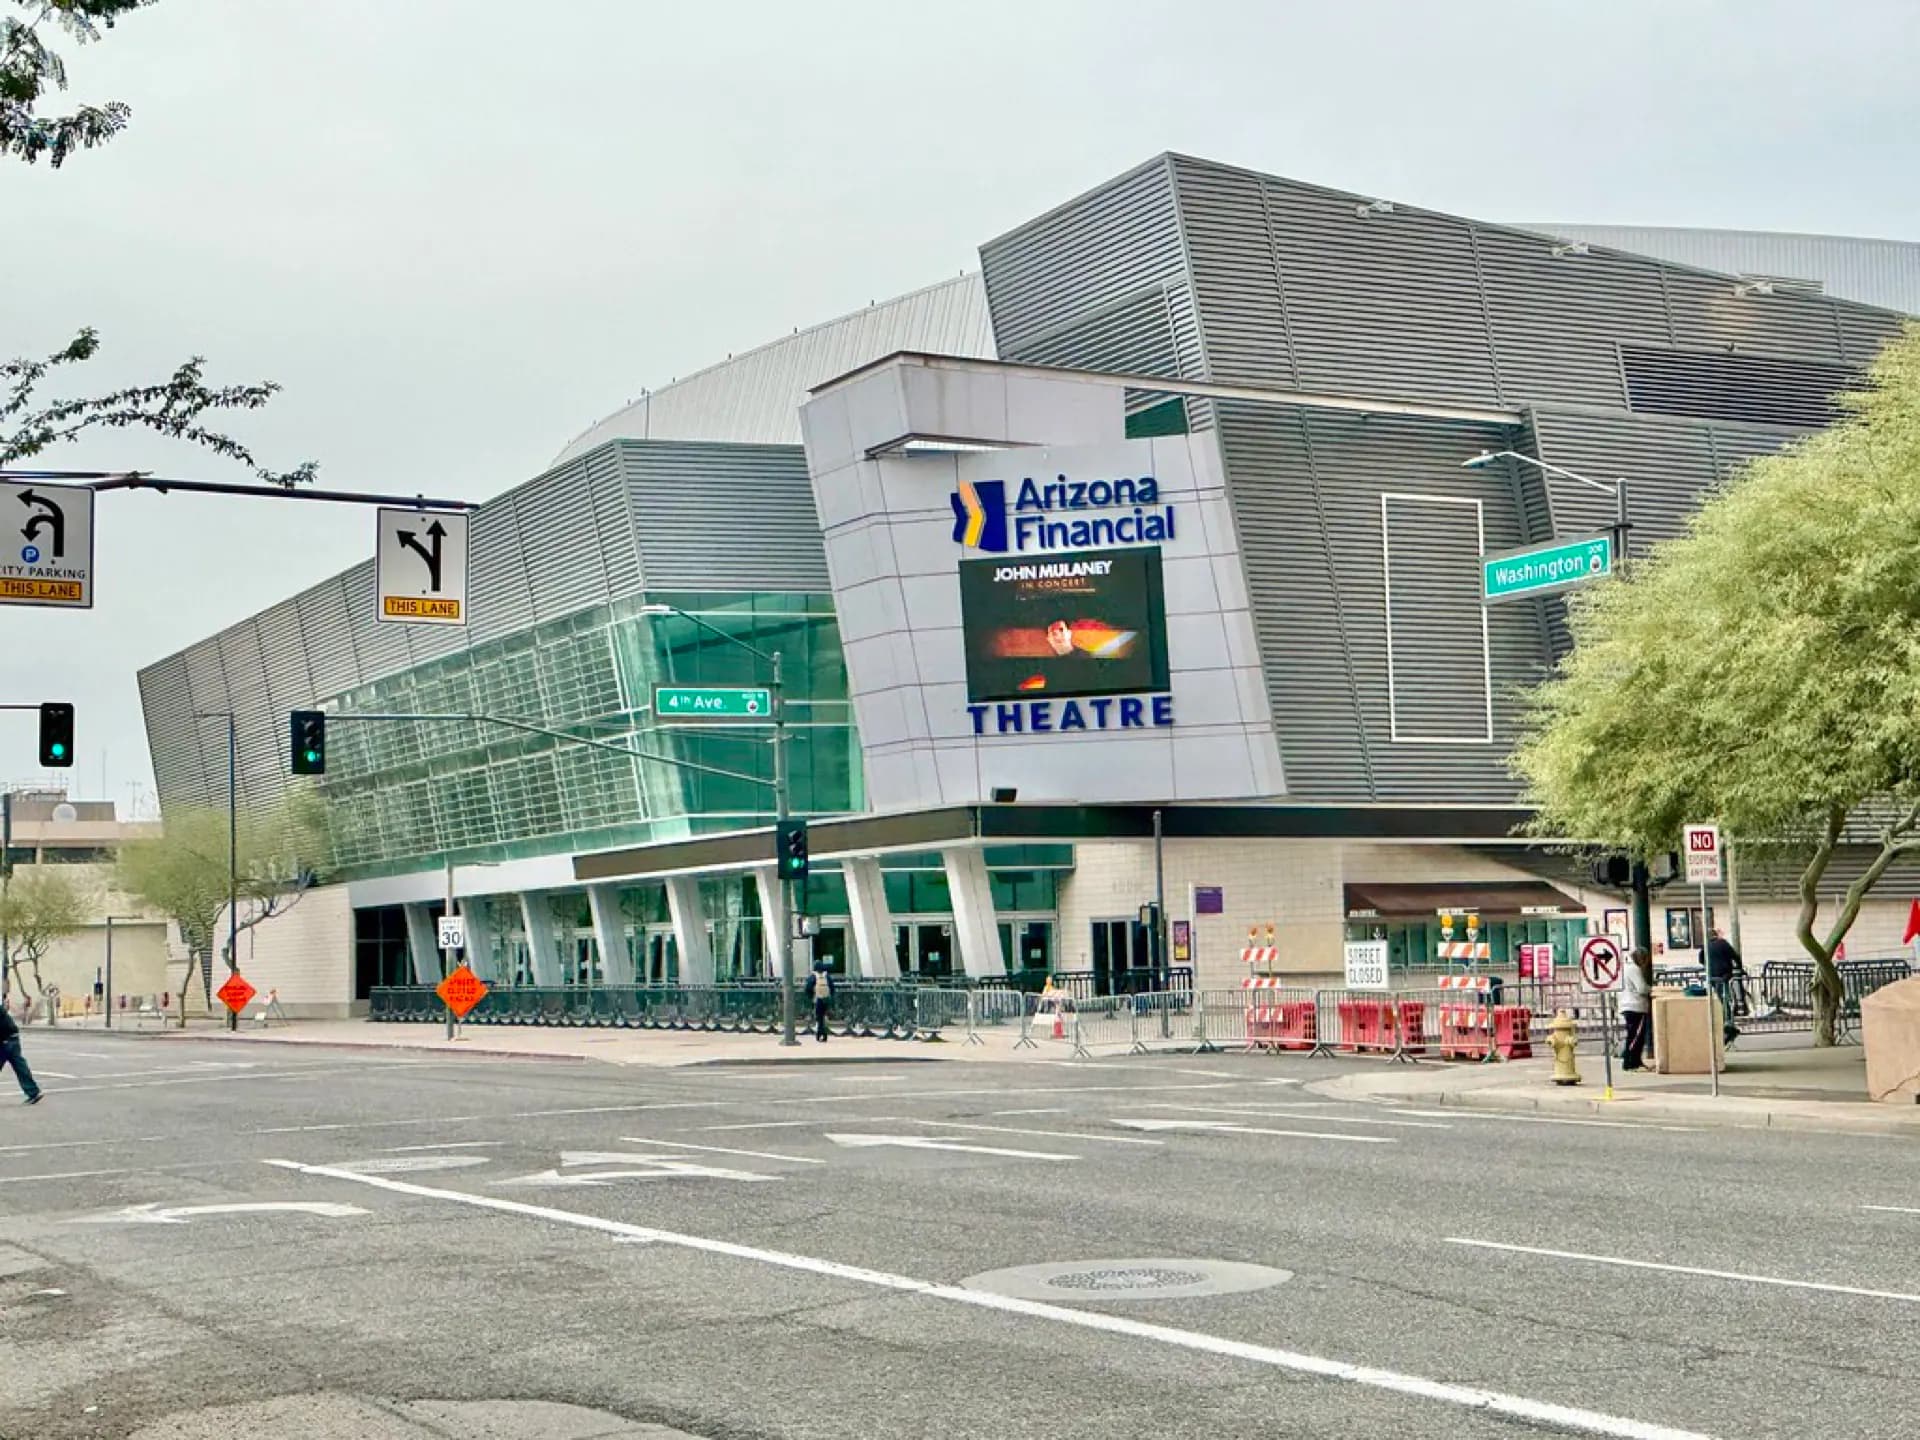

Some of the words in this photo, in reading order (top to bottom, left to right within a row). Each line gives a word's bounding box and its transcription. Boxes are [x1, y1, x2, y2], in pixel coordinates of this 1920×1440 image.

[1015, 474, 1157, 510] Arizona
[1015, 505, 1175, 550] Financial
[0, 565, 24, 576] ITY
[29, 566, 86, 579] PARKING
[993, 564, 1037, 582] JOHN
[1038, 560, 1112, 578] MULANEY
[1495, 556, 1584, 586] Washington
[4, 581, 34, 594] THIS
[38, 583, 77, 597] LANE
[389, 600, 417, 612] THIS
[421, 602, 455, 615] LANE
[967, 695, 1173, 734] THEATRE
[1692, 833, 1711, 849] NO
[441, 931, 461, 946] 30
[1348, 947, 1382, 965] STREET
[1348, 967, 1383, 984] CLOSED
